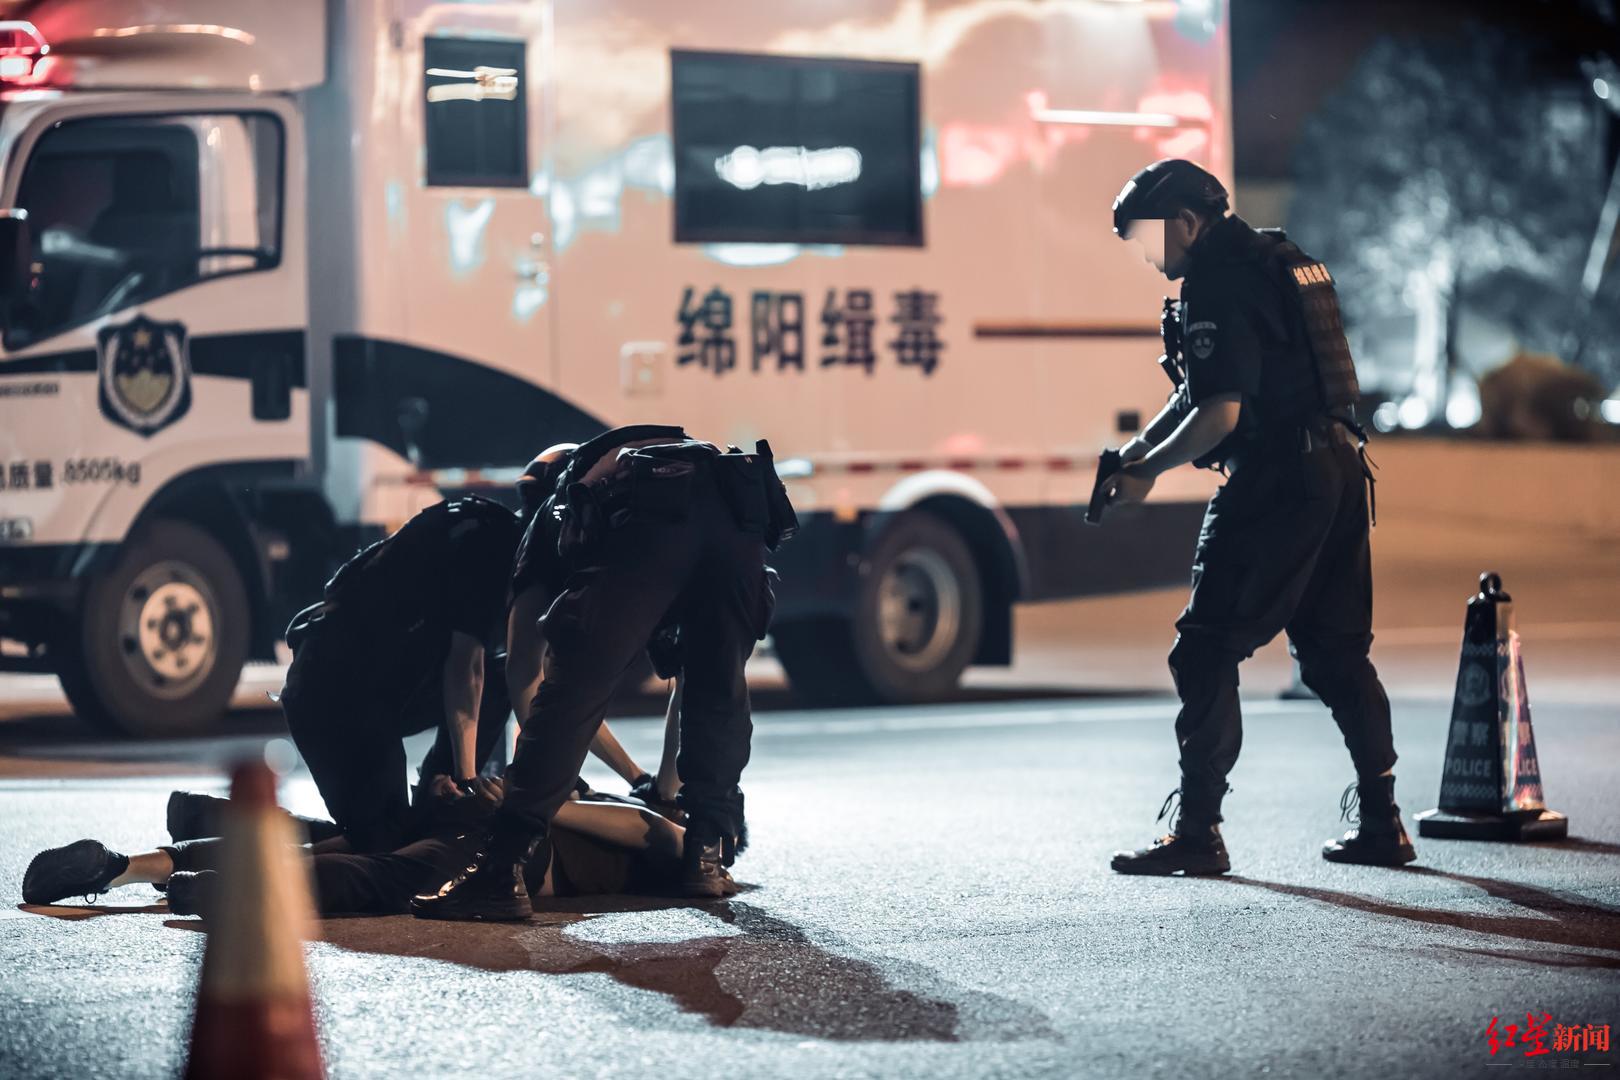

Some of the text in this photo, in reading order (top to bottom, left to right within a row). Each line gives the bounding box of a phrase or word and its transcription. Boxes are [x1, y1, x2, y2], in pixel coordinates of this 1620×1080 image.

[676, 286, 944, 375] 绵阳缉毒
[0, 462, 53, 489] 质量
[1446, 758, 1491, 776] POLICE
